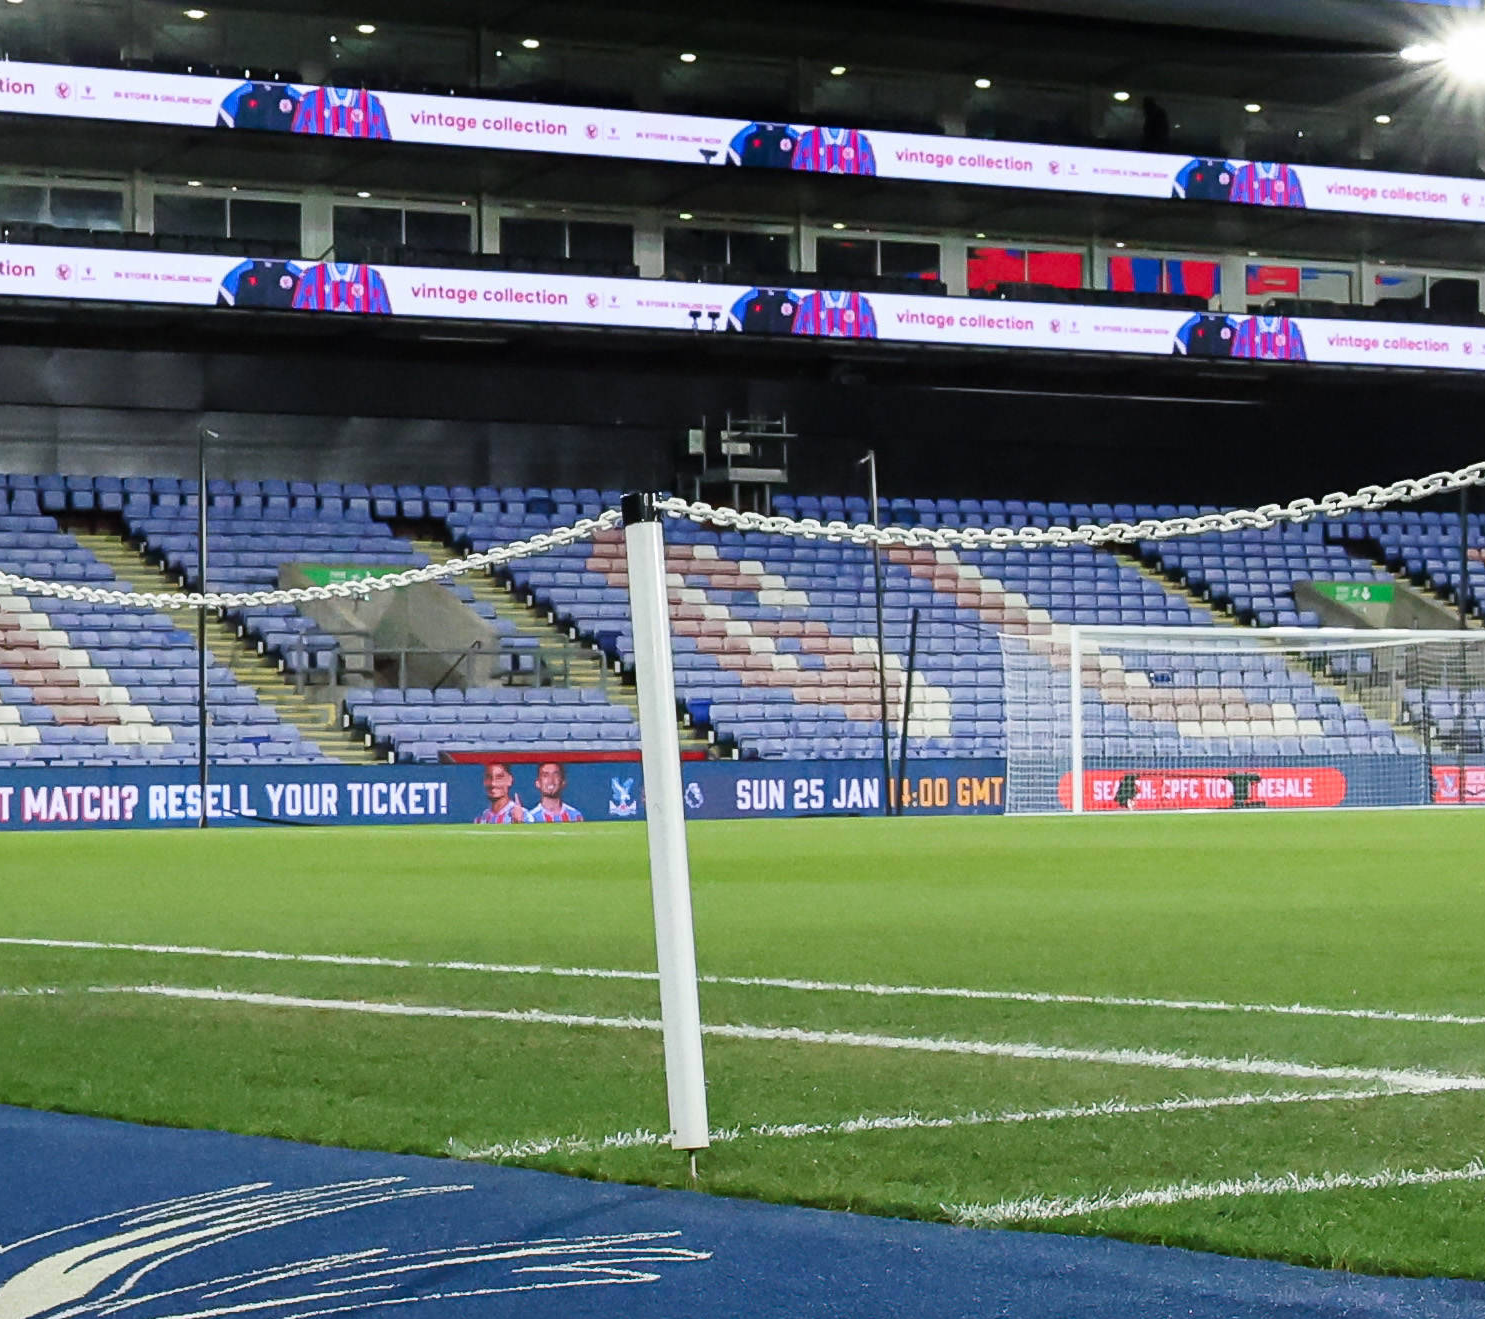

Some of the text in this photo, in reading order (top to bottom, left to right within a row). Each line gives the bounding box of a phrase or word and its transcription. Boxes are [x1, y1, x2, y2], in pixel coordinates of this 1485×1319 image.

[409, 109, 567, 136] vintage collection
[894, 147, 1033, 171] vintage collection
[1325, 181, 1448, 203] vintage collection
[410, 282, 568, 305] vintage collection
[895, 308, 1034, 331] vintage collection
[1326, 332, 1450, 352] vintage collection
[20, 785, 139, 823] MATCH?
[147, 784, 259, 820] RESELL
[265, 783, 338, 817] YOUR
[347, 781, 448, 816] TICKET!
[736, 779, 787, 810] SUN
[793, 778, 825, 810] 25
[832, 778, 880, 809] JAN
[956, 776, 1004, 807] GMT
